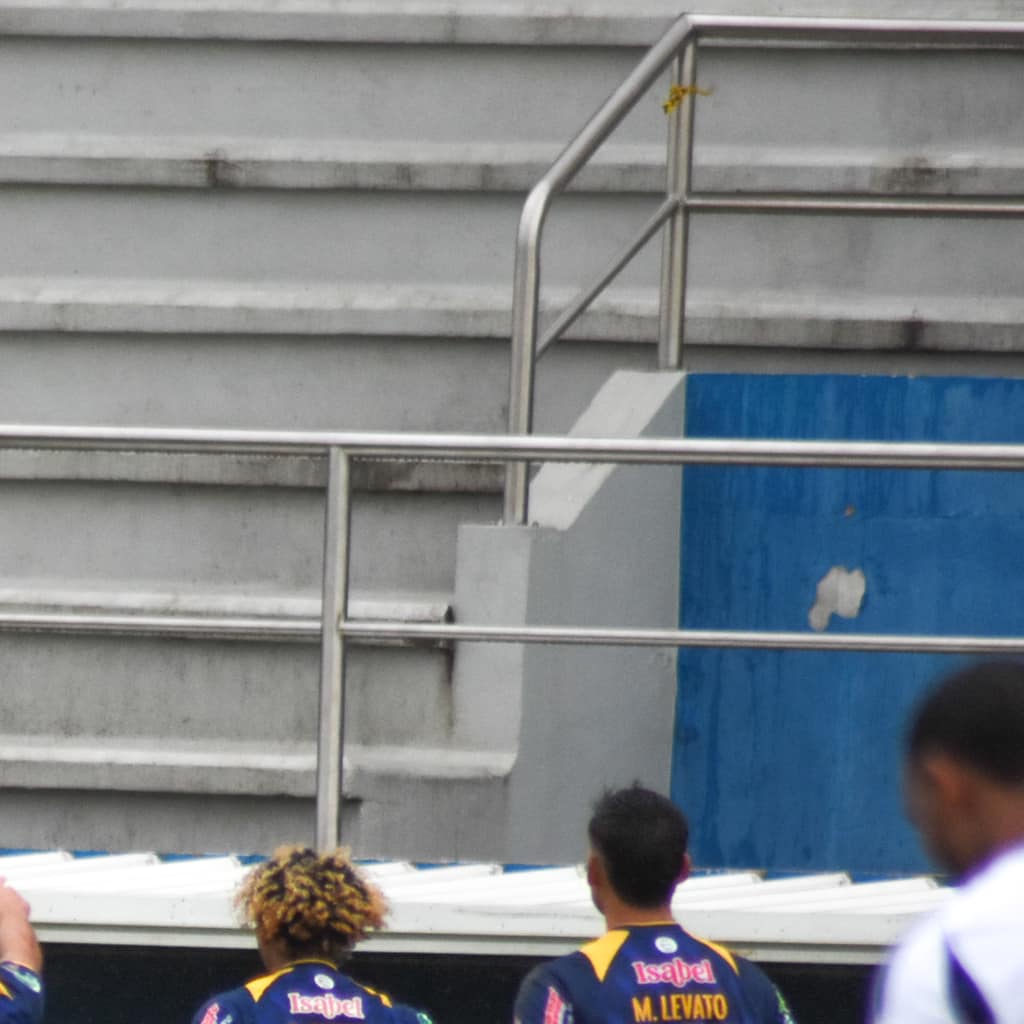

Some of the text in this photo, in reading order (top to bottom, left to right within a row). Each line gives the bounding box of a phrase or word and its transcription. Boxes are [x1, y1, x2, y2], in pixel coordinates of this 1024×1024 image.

[631, 956, 717, 988] Isabel
[287, 992, 366, 1019] Isabel
[632, 994, 728, 1023] M. LEVATO
